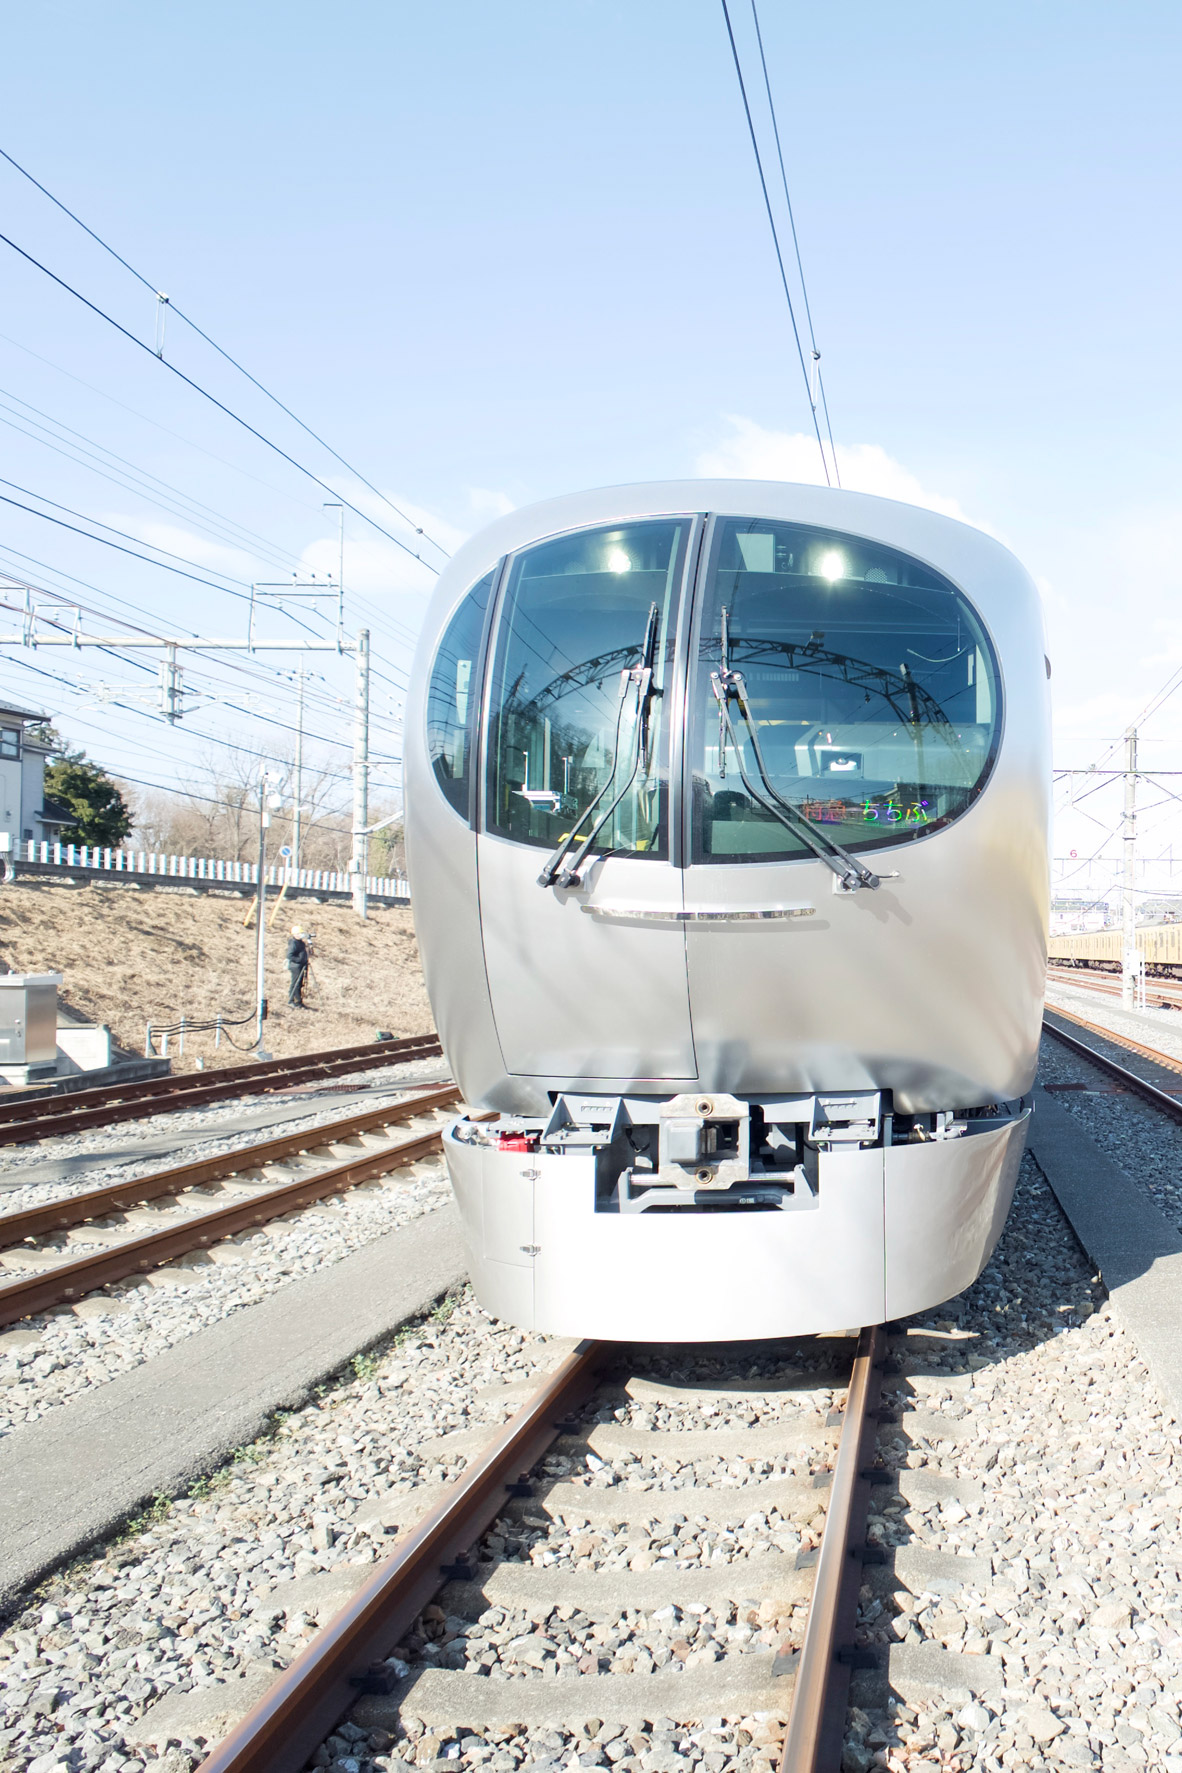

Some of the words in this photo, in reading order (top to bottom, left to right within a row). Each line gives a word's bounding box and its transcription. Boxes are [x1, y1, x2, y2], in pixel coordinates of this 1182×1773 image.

[860, 800, 929, 823] ちちぶ
[1070, 849, 1078, 858] 6
